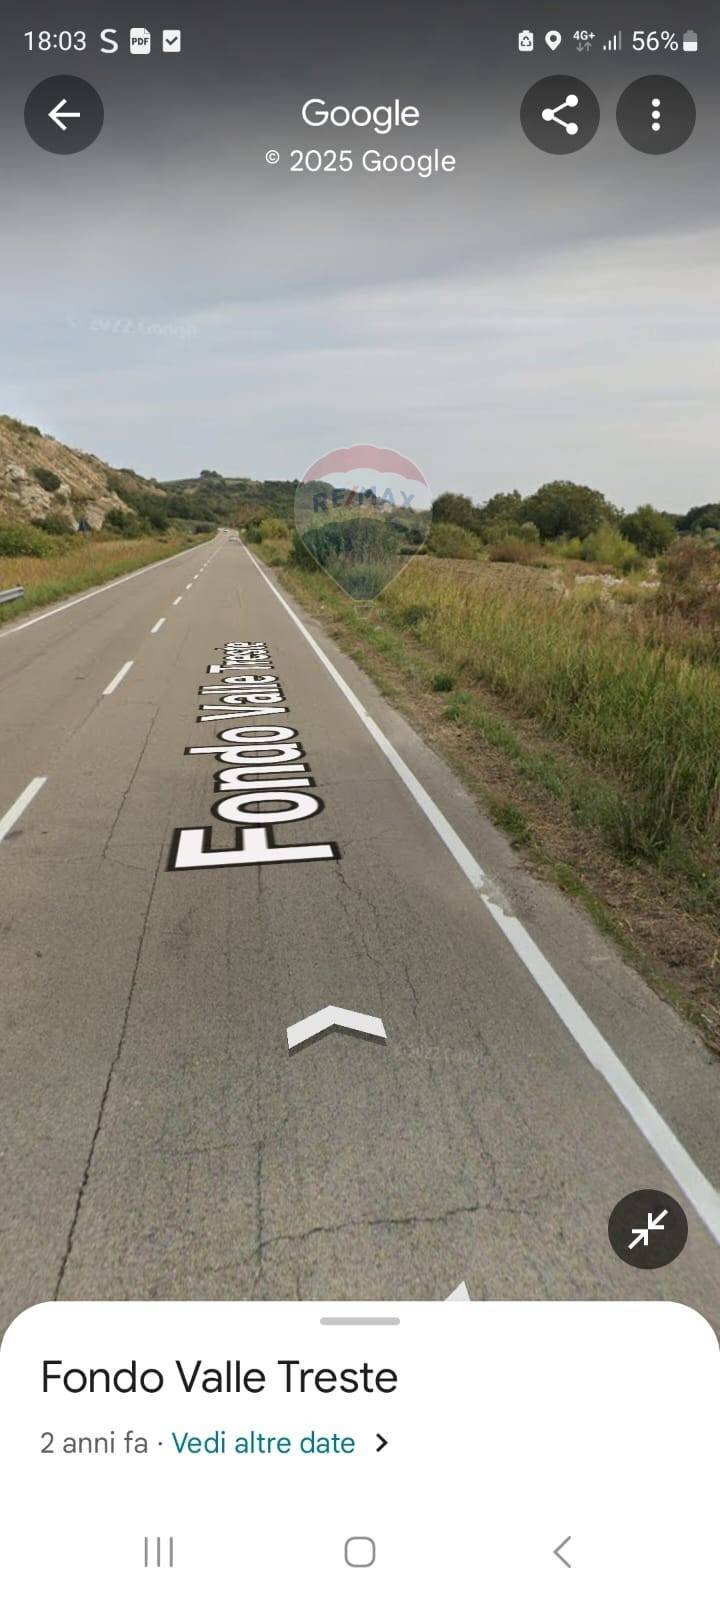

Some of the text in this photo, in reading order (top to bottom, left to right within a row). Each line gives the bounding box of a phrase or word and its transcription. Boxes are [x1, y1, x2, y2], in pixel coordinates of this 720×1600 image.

[24, 30, 87, 51] 18:03
[131, 37, 150, 46] PDF
[572, 30, 596, 41] 4G+
[632, 30, 679, 51] 56%
[301, 98, 420, 134] Google
[290, 149, 353, 172] 2025
[362, 148, 456, 178] Google
[42, 1359, 398, 1394] Fondo Valle Treste
[40, 1429, 148, 1454] 2 anni fa
[171, 1430, 356, 1454] Vedi altre date
